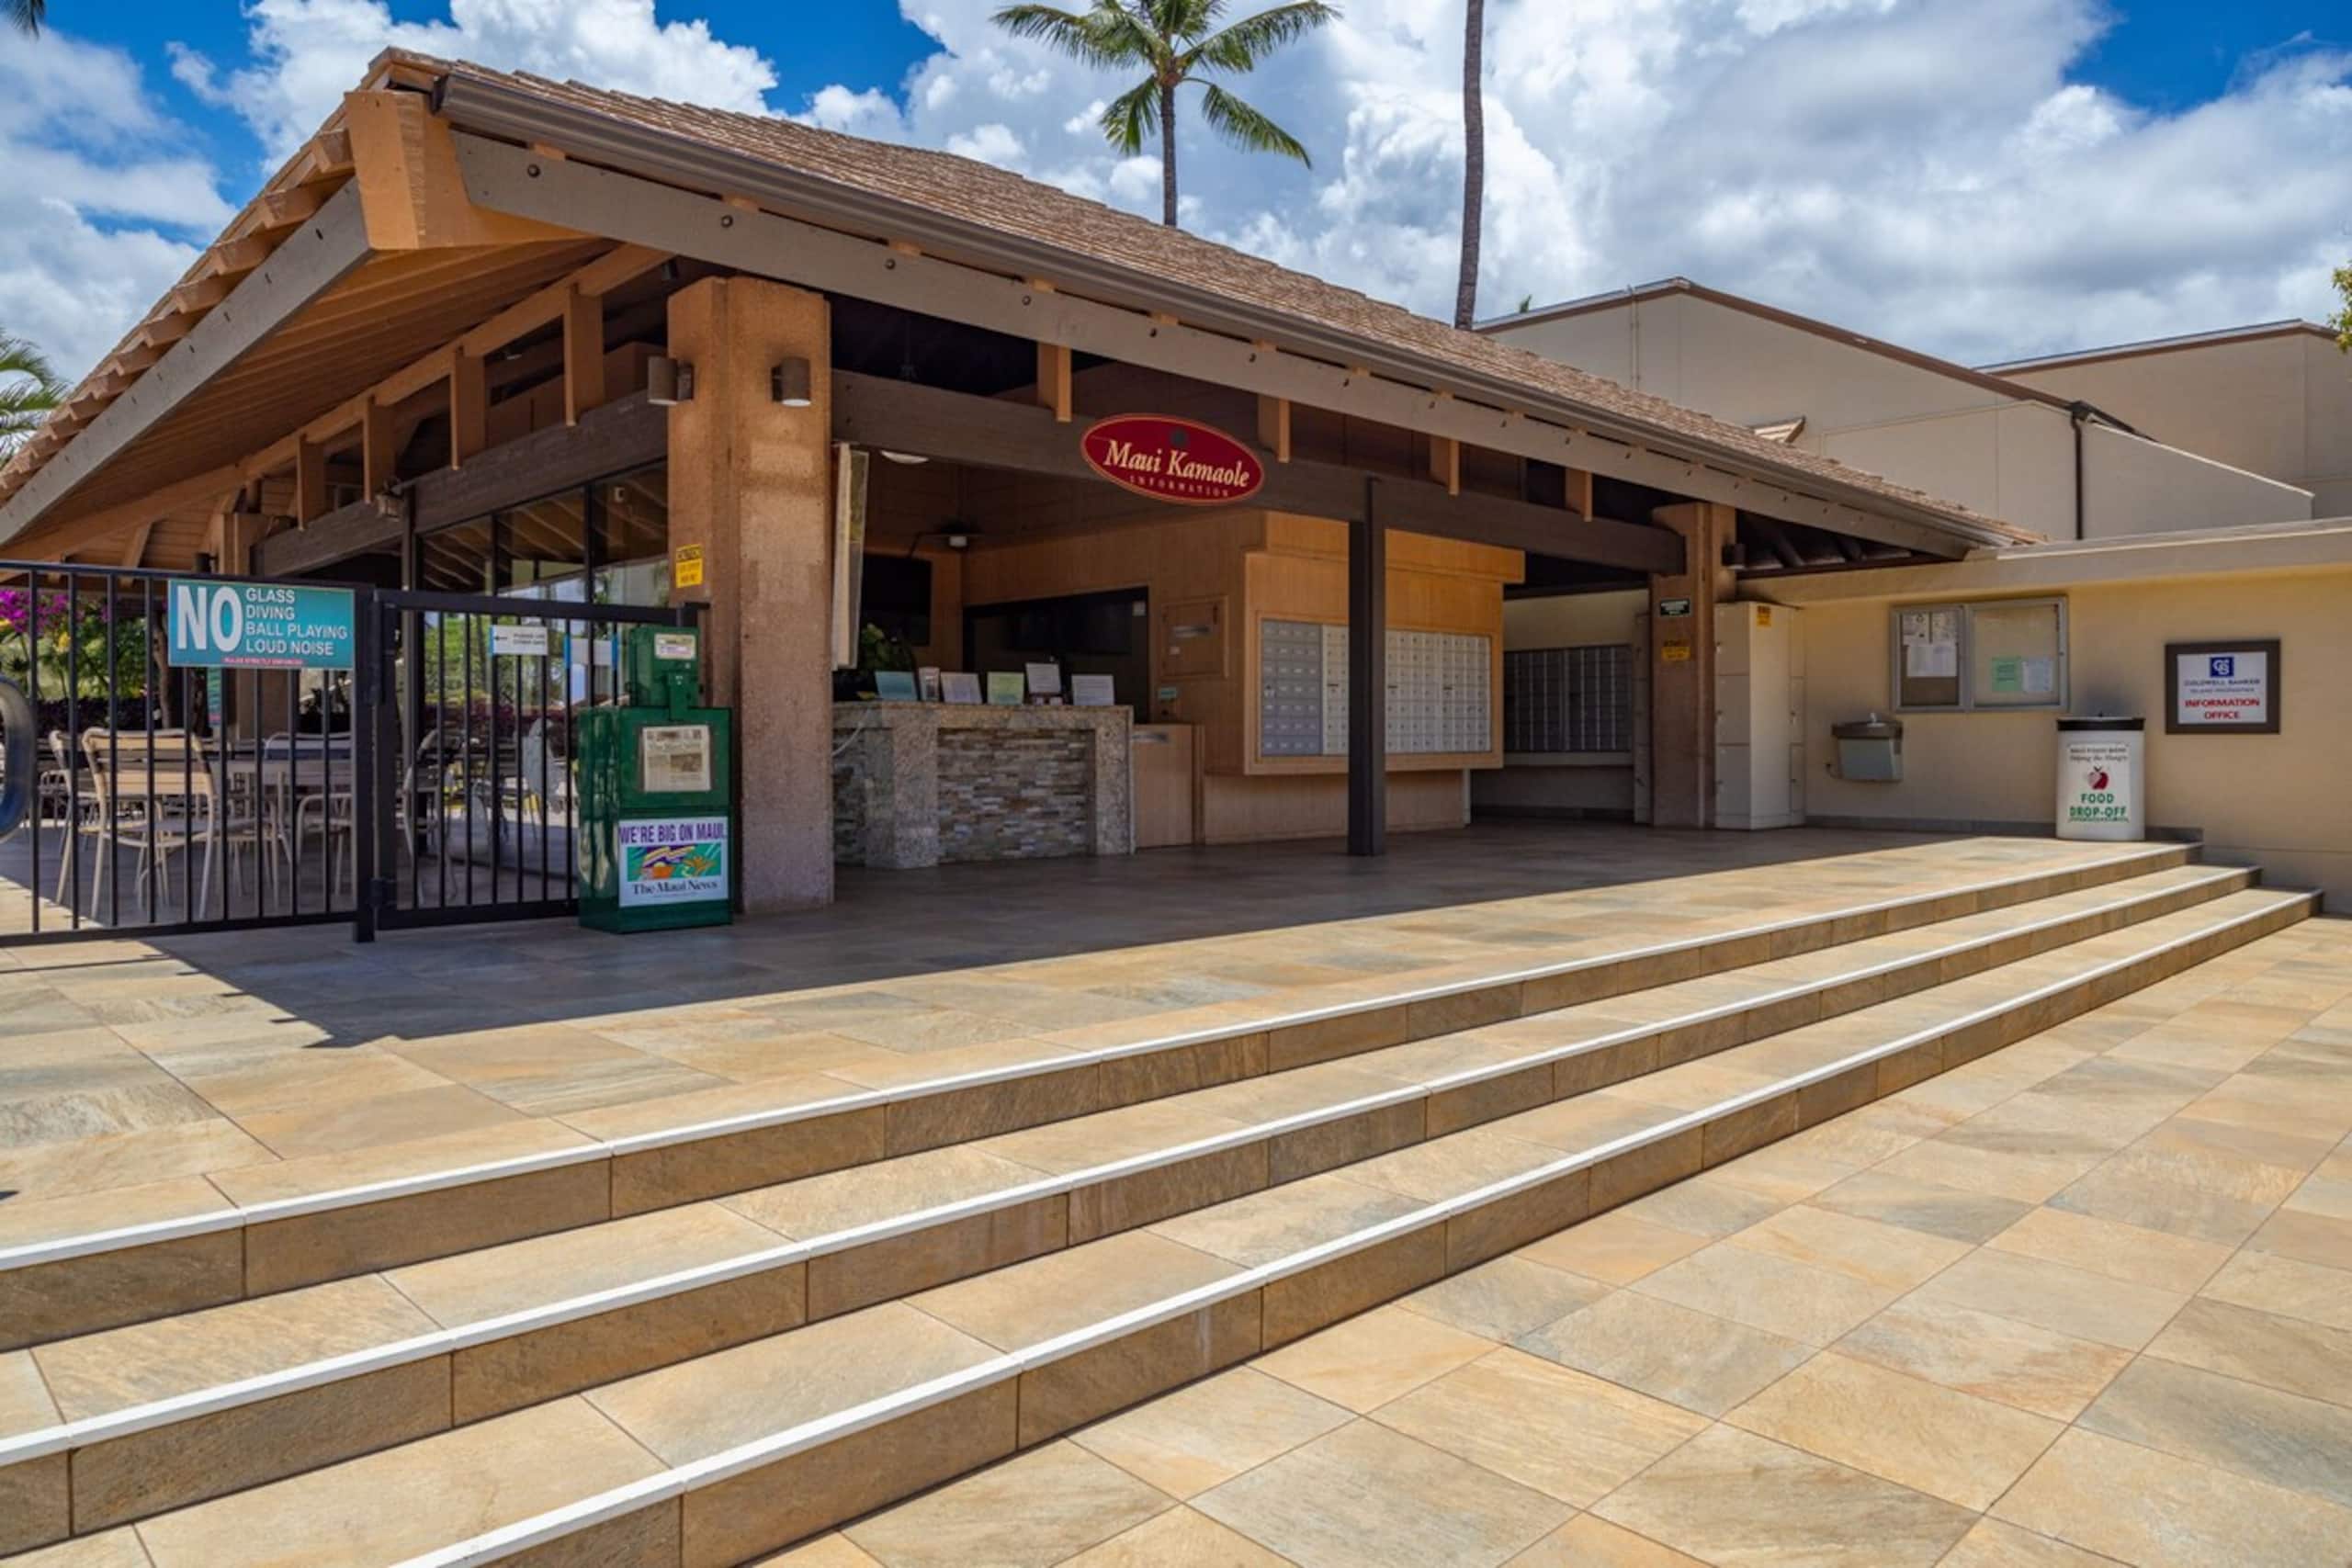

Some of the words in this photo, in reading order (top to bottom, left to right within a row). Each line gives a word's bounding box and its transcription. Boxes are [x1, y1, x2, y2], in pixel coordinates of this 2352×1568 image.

[1102, 438, 1163, 474] Maui
[1166, 448, 1250, 488] Kamaole
[1129, 474, 1229, 498] INFORMATION
[245, 587, 295, 604] GLASS
[176, 585, 243, 653] NO
[245, 604, 295, 621] DIVING
[245, 621, 284, 636] BALL
[287, 623, 348, 640] PLAYING
[245, 638, 288, 654] LOUD
[290, 641, 334, 656] NOISE
[2184, 698, 2260, 707] INFORMATION
[2204, 711, 2239, 719] OFFICE
[2080, 793, 2114, 804] FOOD
[2069, 806, 2127, 817] DROP-OFF
[618, 824, 654, 844] WE'RE
[658, 823, 677, 842] BIG
[680, 823, 694, 841] ON
[632, 884, 656, 896] The
[657, 881, 687, 893] Maui
[687, 880, 718, 891] News
